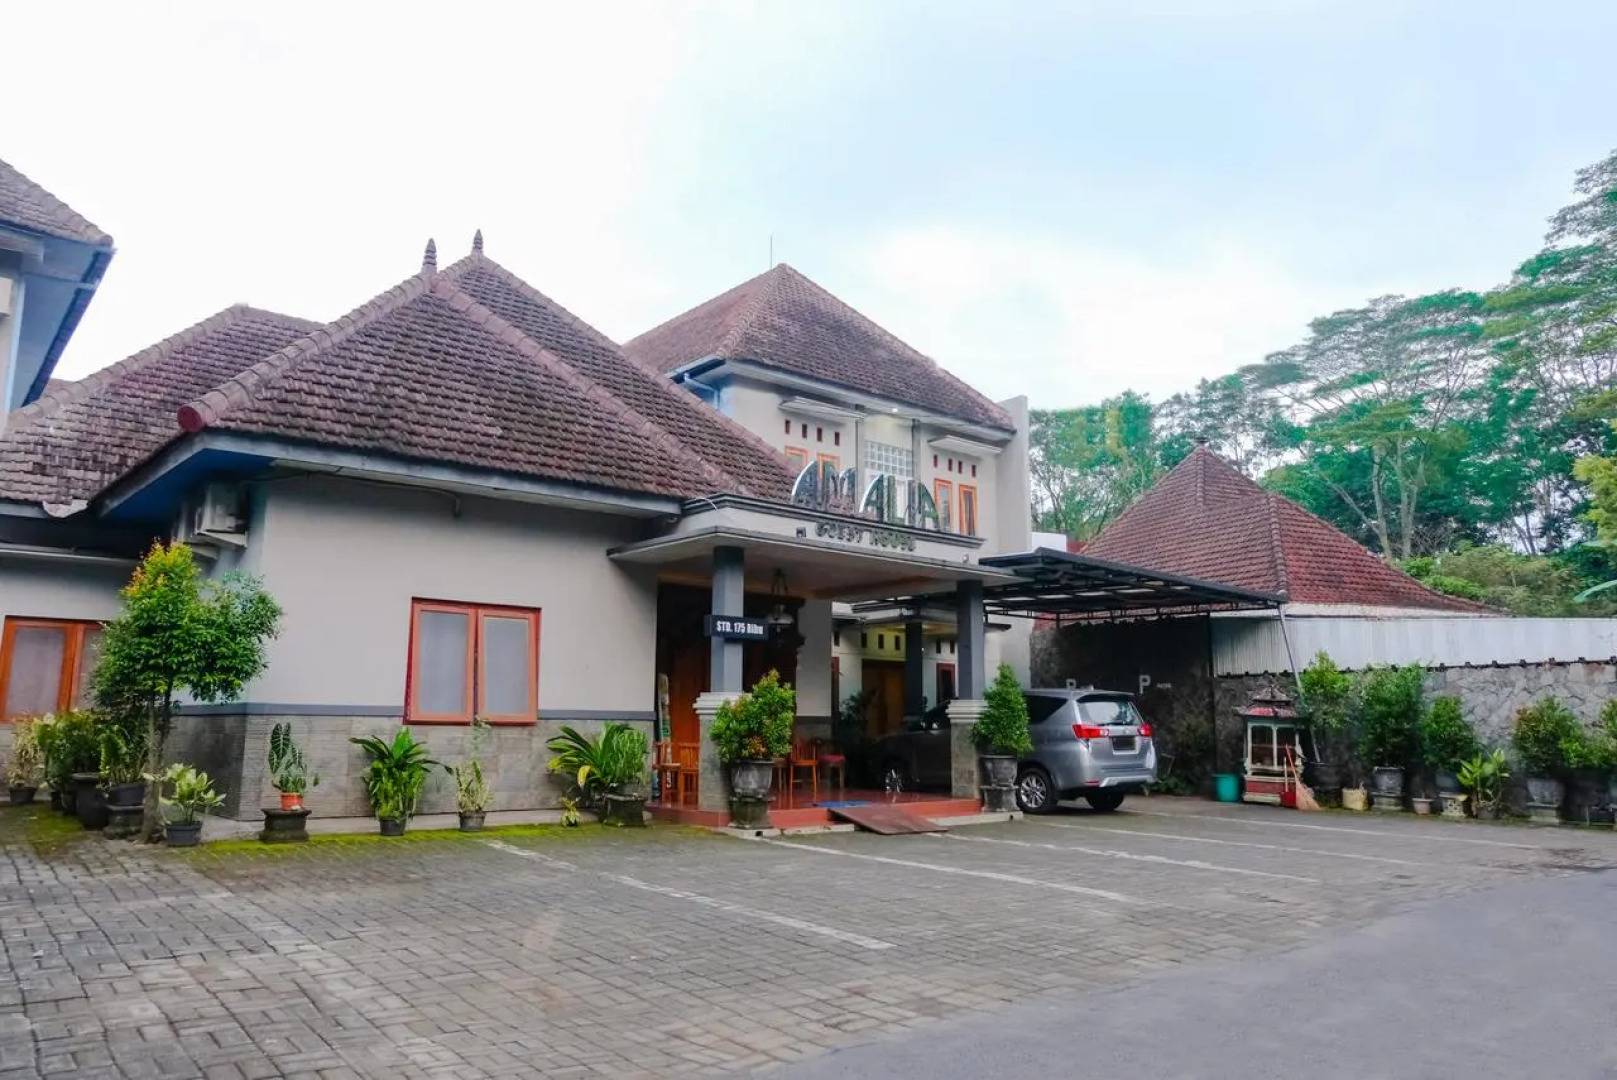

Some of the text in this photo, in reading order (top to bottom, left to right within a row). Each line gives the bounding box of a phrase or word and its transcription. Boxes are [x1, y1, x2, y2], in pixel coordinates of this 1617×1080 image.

[815, 518, 861, 544] GUEST
[716, 620, 733, 633] STD.
[734, 622, 746, 634] 175
